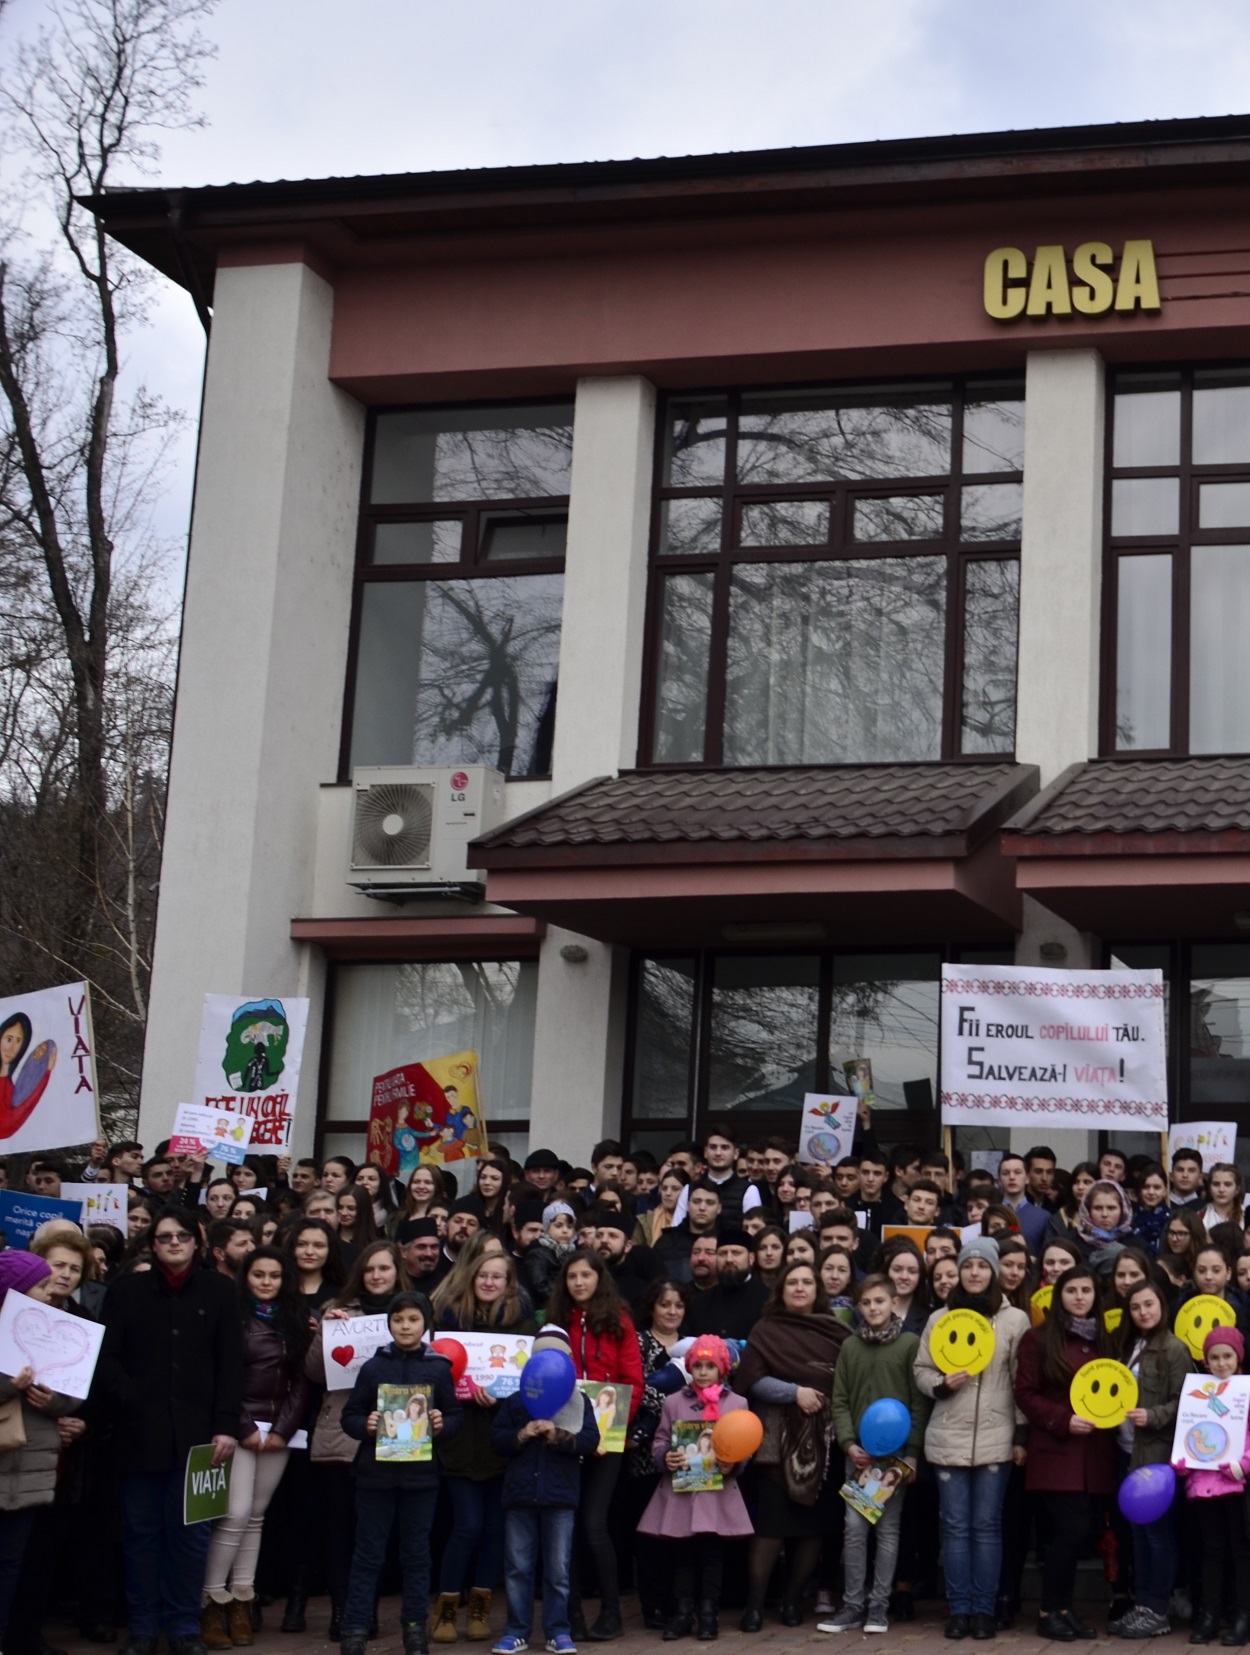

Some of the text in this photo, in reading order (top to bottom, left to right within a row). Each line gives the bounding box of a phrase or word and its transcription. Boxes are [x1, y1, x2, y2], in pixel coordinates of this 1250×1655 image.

[984, 239, 1161, 319] CASA
[451, 792, 466, 802] LG
[986, 1023, 1034, 1039] EROUL
[191, 1461, 227, 1500] VIAȚĂ
